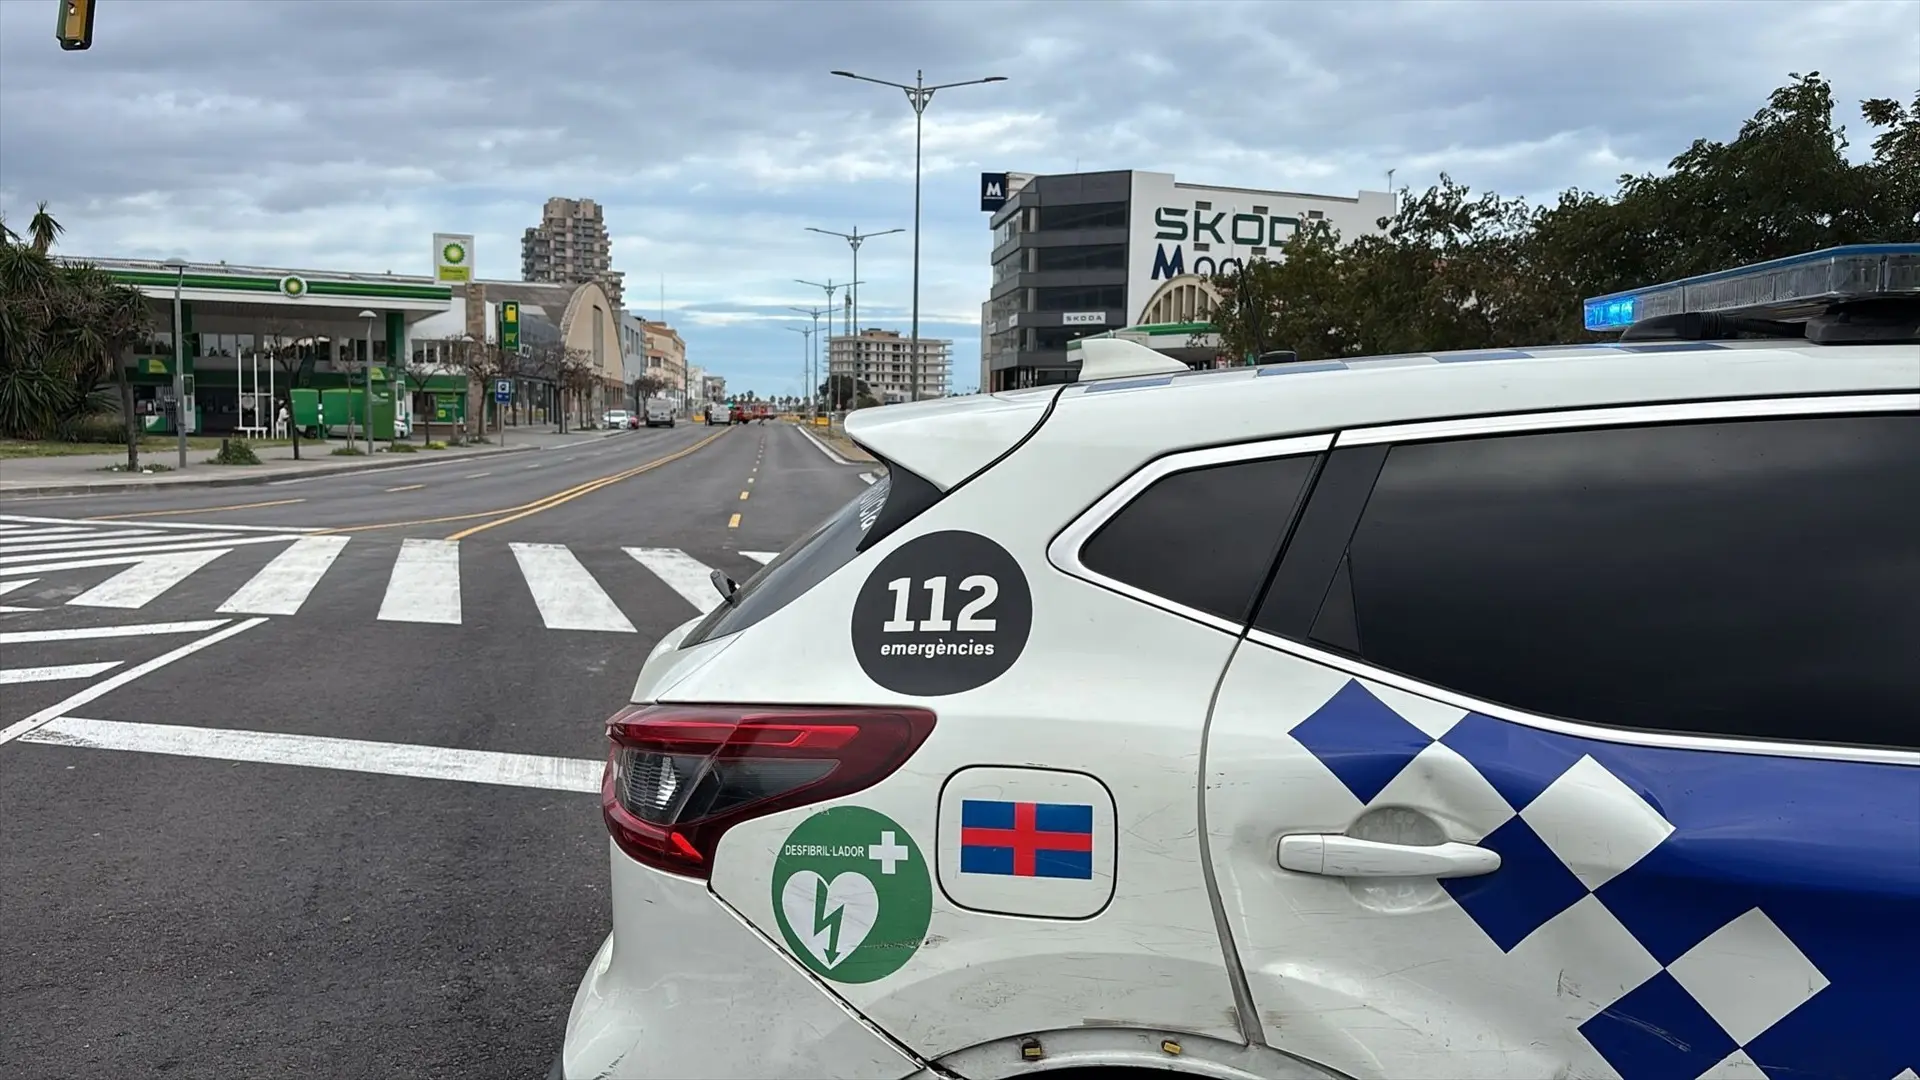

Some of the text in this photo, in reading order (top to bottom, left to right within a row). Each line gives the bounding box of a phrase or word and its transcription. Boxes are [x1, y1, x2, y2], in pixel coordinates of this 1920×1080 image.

[986, 181, 1002, 196] M
[883, 575, 999, 632] 112
[880, 638, 995, 659] emergències
[785, 844, 865, 857] DESFIBRIL·LADOR
